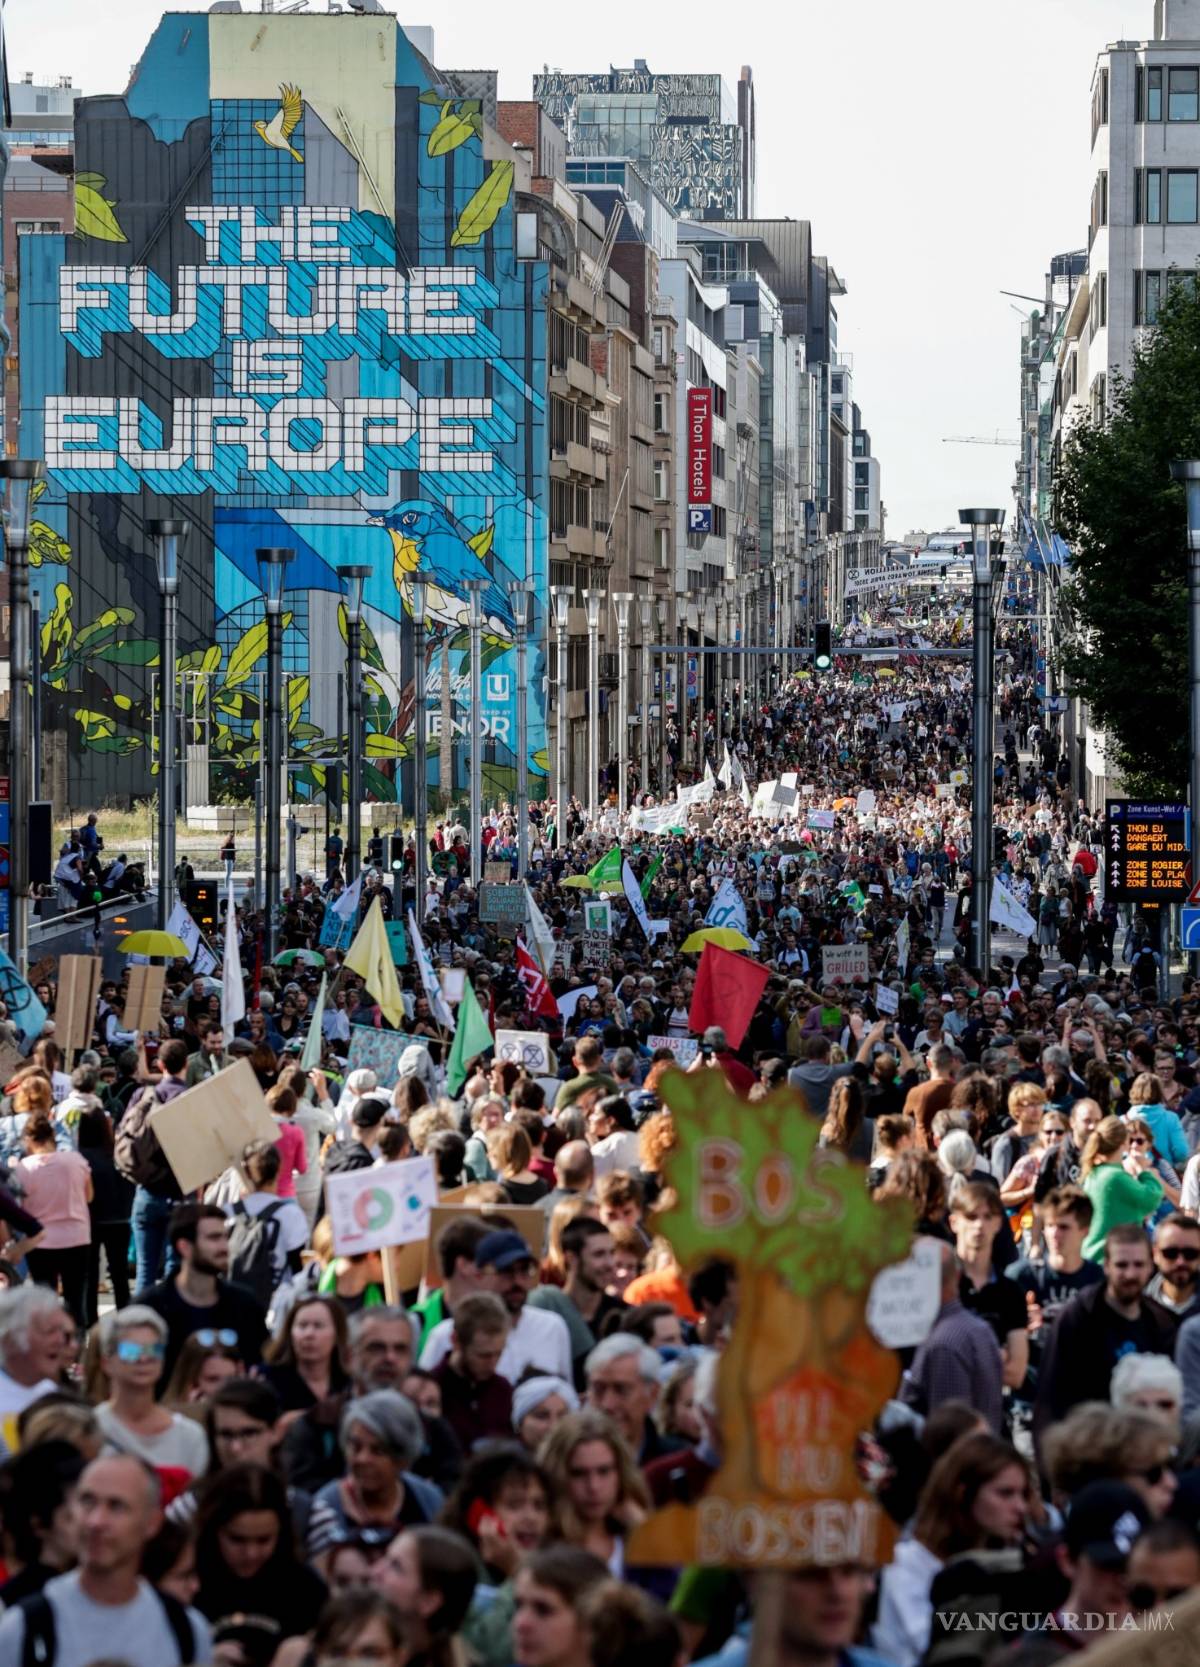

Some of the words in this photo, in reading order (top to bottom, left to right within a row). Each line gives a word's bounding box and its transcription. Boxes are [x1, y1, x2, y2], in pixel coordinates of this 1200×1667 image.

[184, 206, 352, 263] THE
[59, 265, 477, 335] FUTURE
[233, 339, 303, 394] IS
[693, 404, 707, 443] Thon
[44, 396, 494, 472] EUROPE
[693, 449, 707, 497] Hotels
[691, 511, 704, 527] P
[1110, 805, 1121, 818] P
[1127, 805, 1143, 813] Zone
[1144, 805, 1175, 813] Kunst-Wet
[1127, 825, 1148, 833] THON
[1152, 825, 1163, 833] EU
[1127, 834, 1168, 842] DANSAERT
[1127, 843, 1149, 851] GARE
[1152, 843, 1163, 851] DU
[1127, 861, 1148, 869] ZONE
[1152, 861, 1183, 869] ROGIER
[1127, 870, 1148, 878] ZONE
[1127, 879, 1148, 887] ZONE
[1152, 879, 1183, 887] LOUISE
[584, 929, 608, 940] SOS
[827, 960, 866, 974] GRILLED
[694, 1136, 846, 1231] BOS
